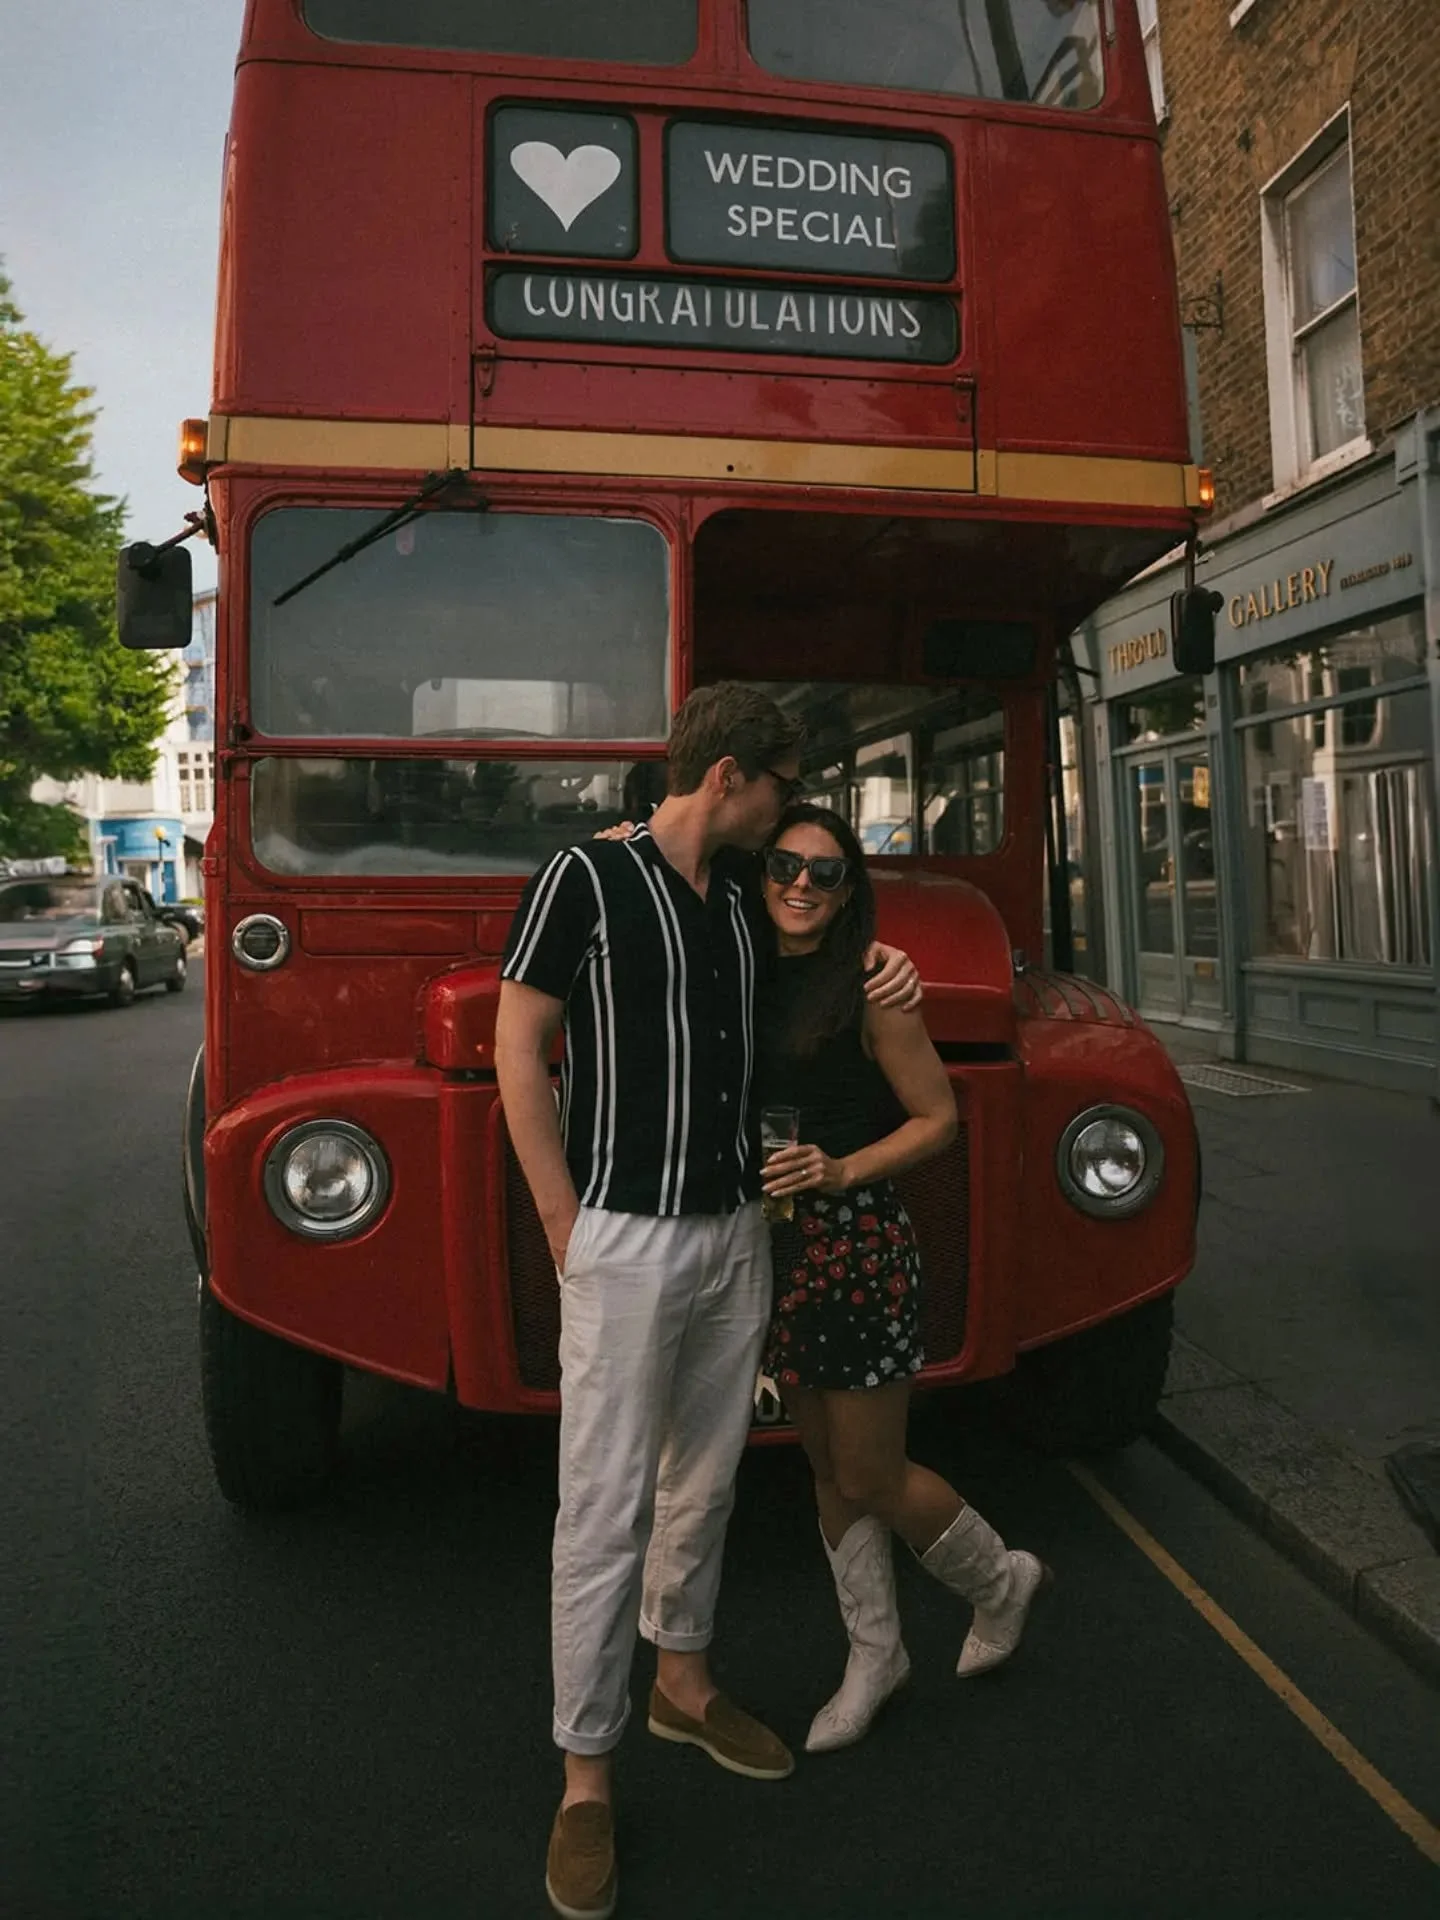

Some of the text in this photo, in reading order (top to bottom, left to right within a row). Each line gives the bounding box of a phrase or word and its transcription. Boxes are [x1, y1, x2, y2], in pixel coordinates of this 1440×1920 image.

[704, 151, 912, 198] WEDDING
[727, 205, 896, 249] SPECIAL
[523, 275, 921, 338] CONGRATULATIONS
[1228, 560, 1333, 628] GALLERY
